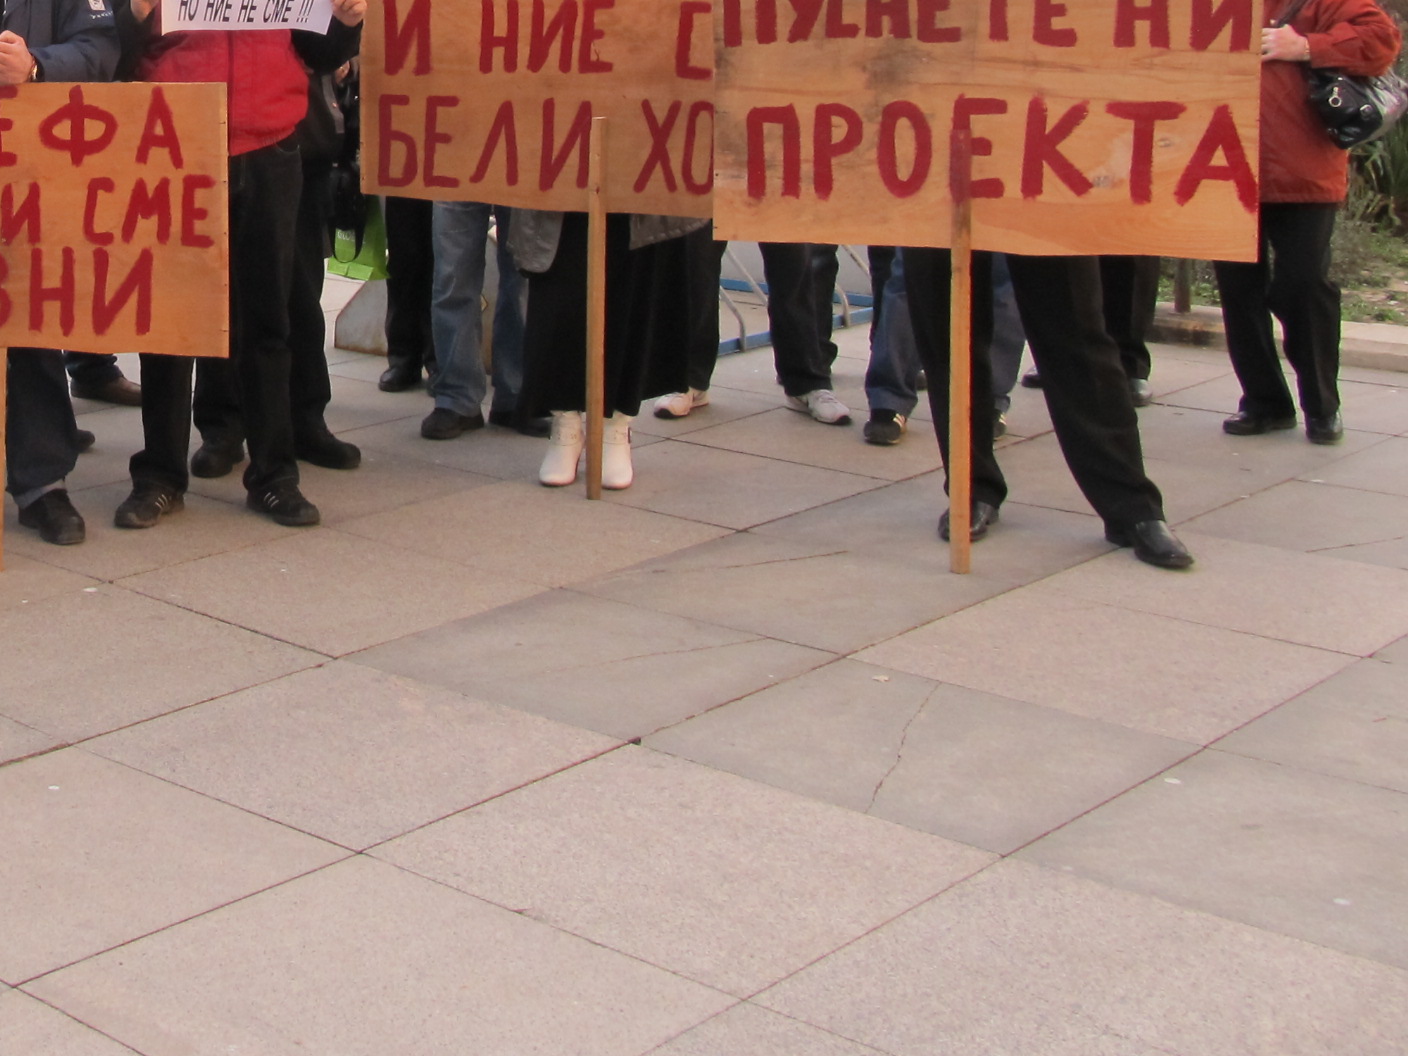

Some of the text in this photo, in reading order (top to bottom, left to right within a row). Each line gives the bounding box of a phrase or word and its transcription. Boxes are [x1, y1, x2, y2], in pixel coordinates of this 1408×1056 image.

[675, 0, 713, 80] С
[377, 94, 714, 195] БЕЛИ ХО
[745, 93, 1258, 214] ПРОЕКТА
[83, 174, 216, 249] СМЕ
